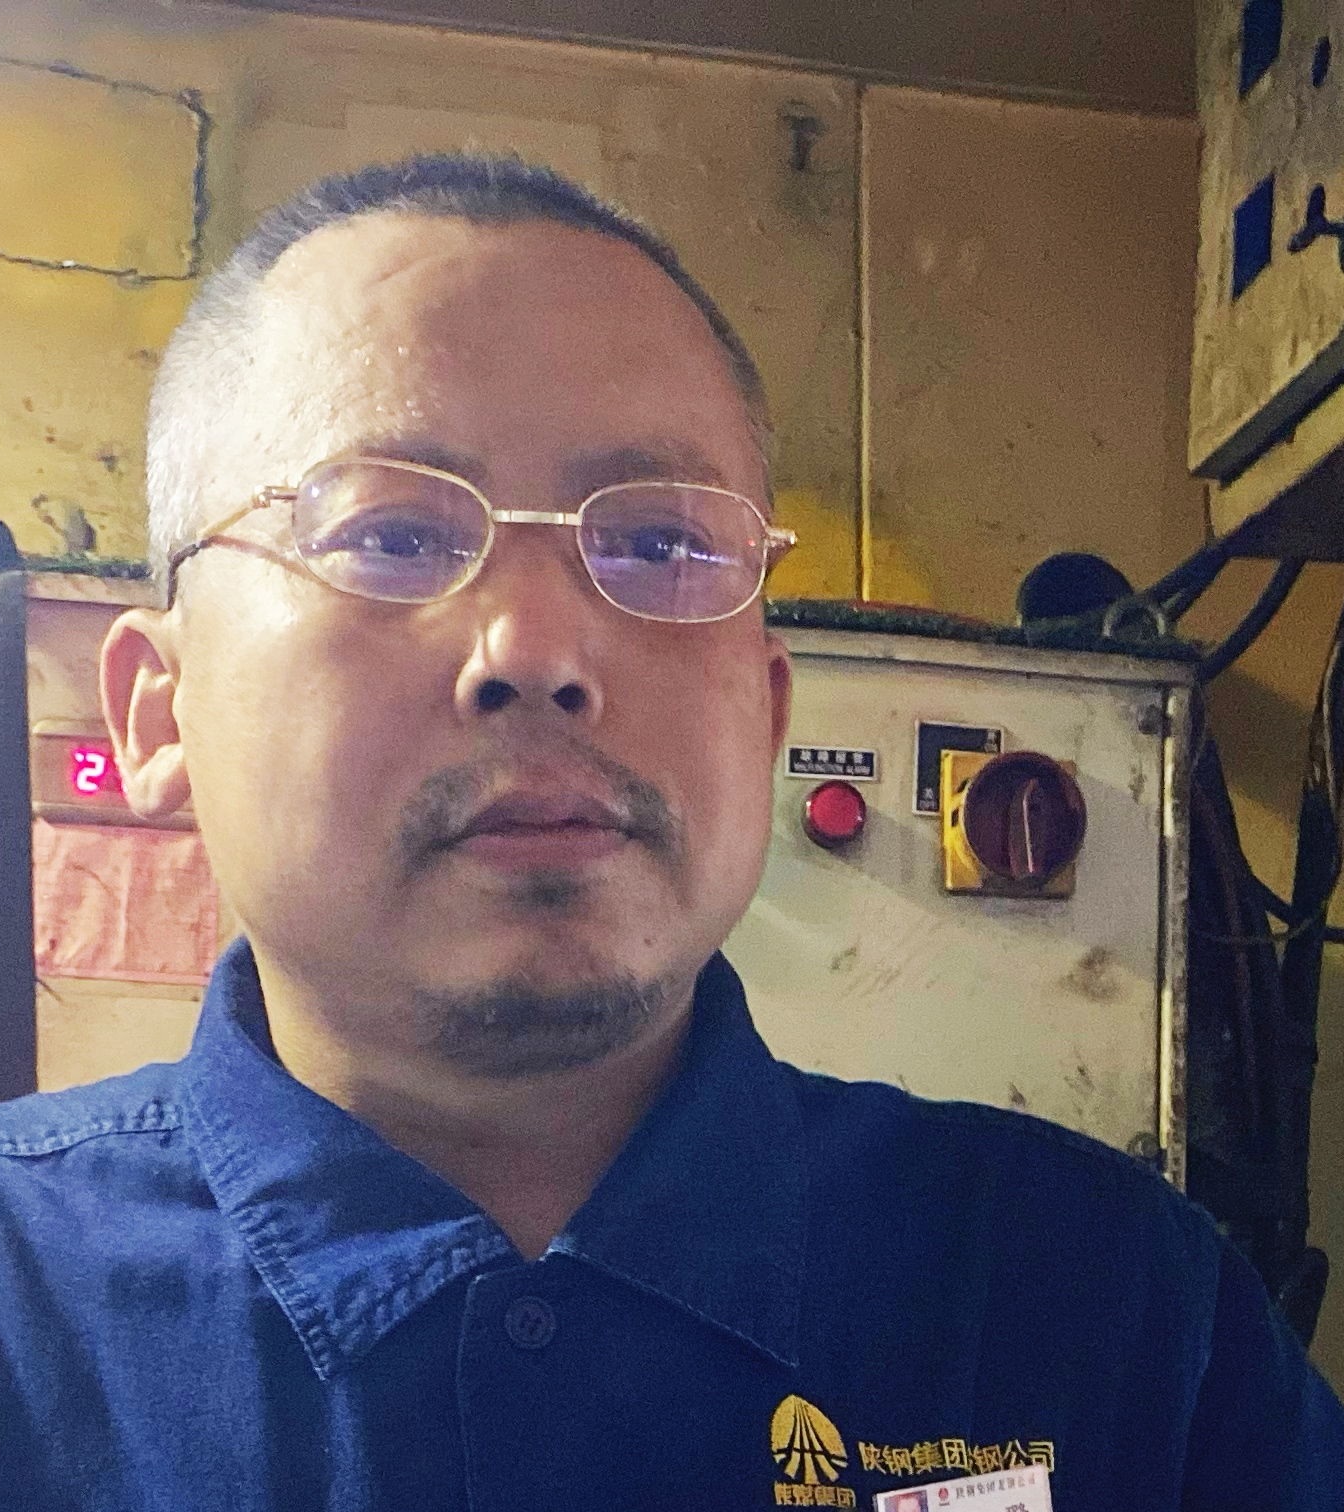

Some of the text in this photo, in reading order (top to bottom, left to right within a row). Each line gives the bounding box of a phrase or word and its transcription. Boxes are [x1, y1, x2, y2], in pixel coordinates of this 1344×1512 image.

[858, 1438, 1054, 1478] 陕钢集团钢公司
